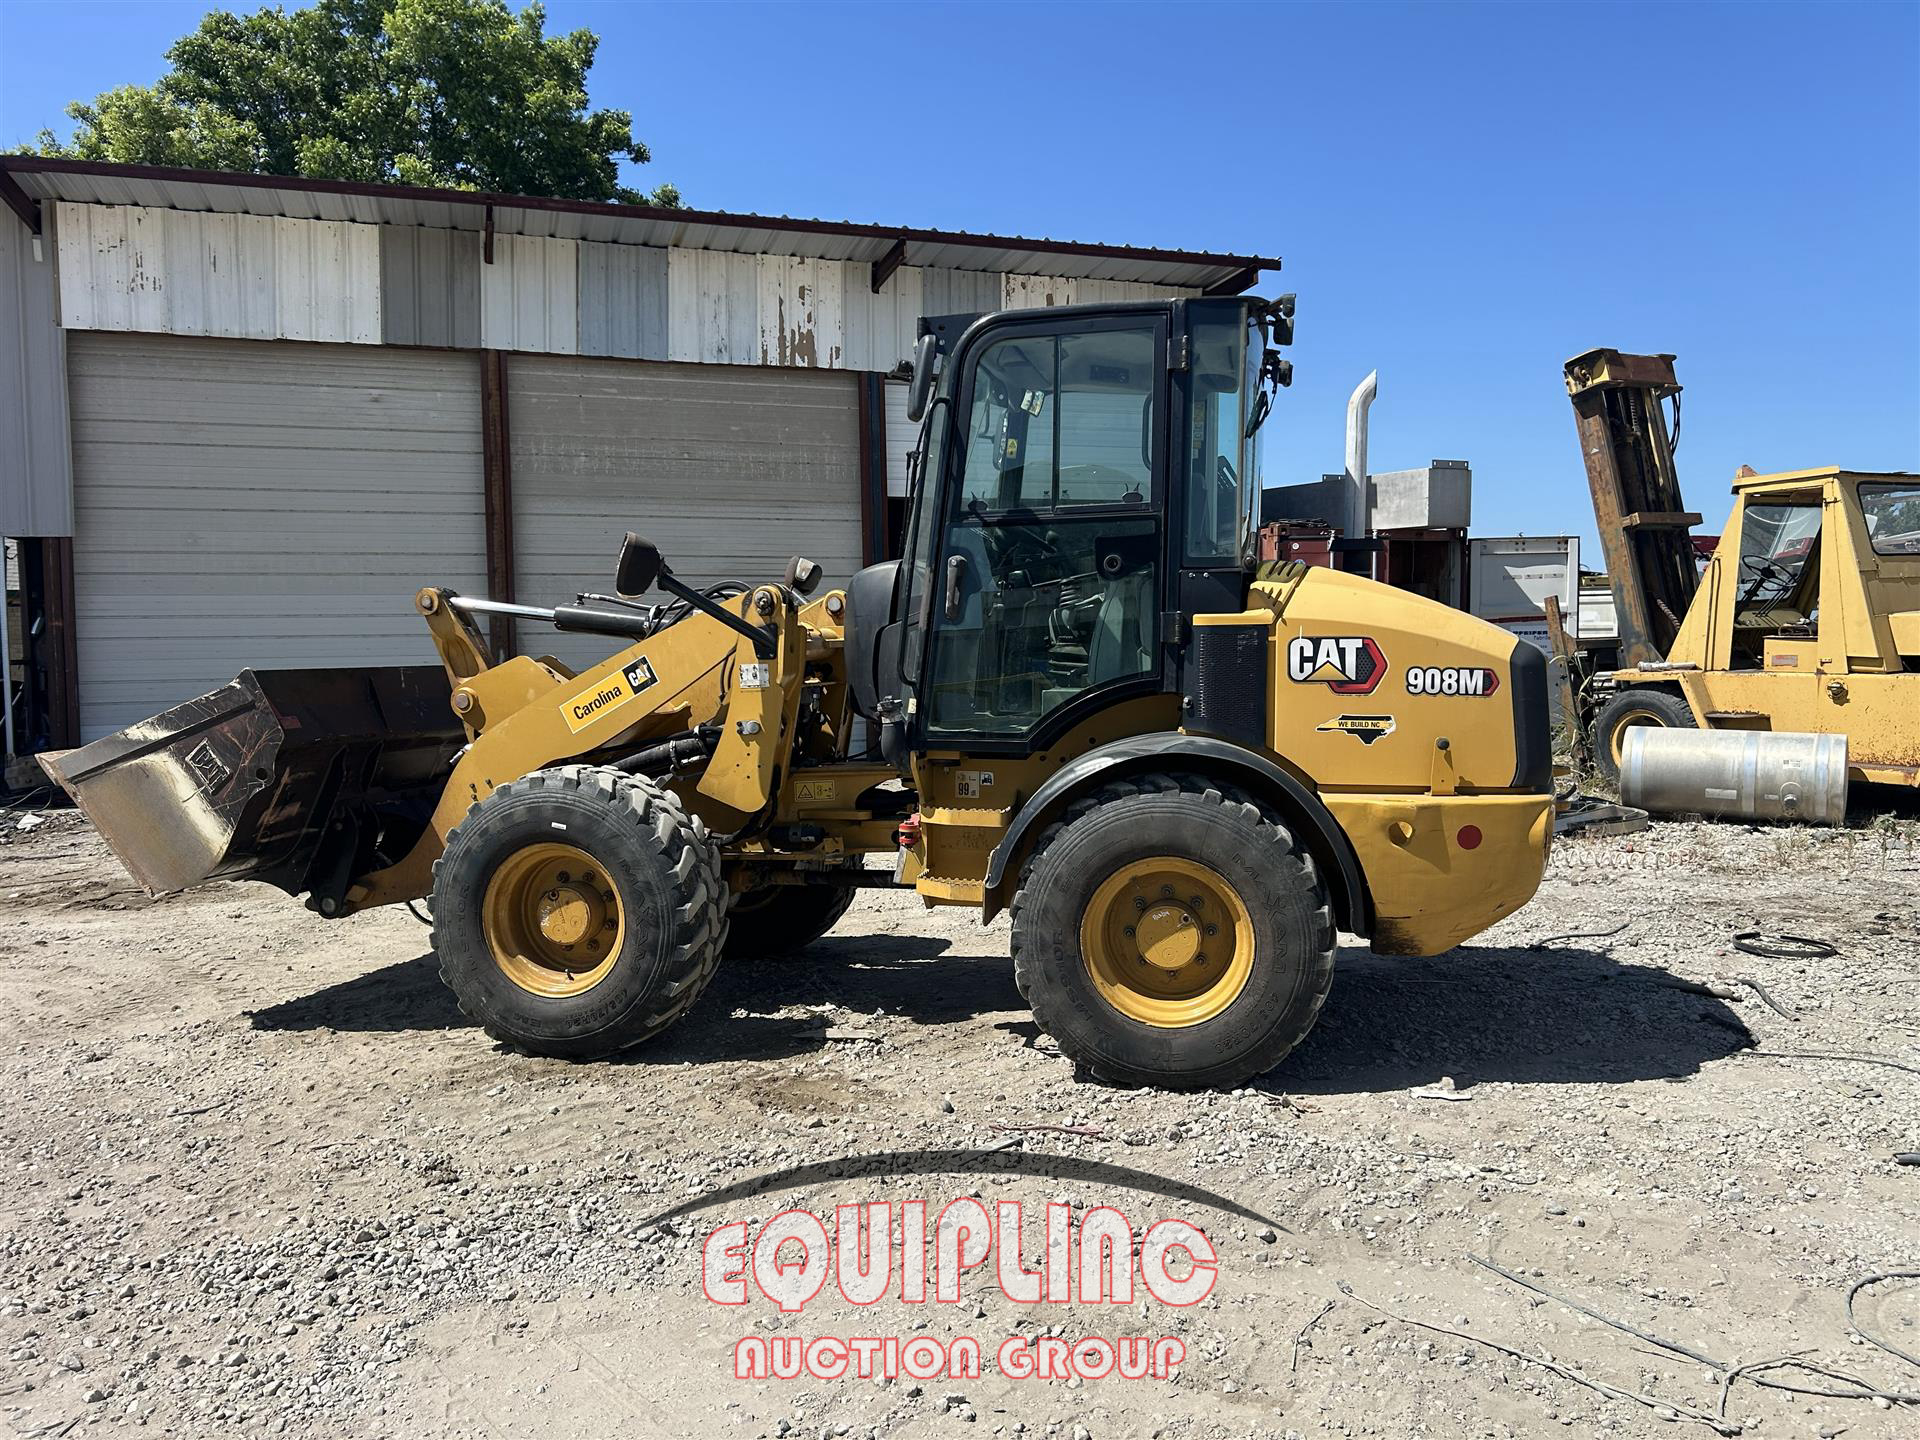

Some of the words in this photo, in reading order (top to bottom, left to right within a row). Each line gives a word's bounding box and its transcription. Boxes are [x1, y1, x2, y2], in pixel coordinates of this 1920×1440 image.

[1290, 638, 1363, 681] CAT
[1407, 667, 1484, 695] 908M
[573, 686, 622, 720] Carolina
[628, 663, 652, 687] CAT
